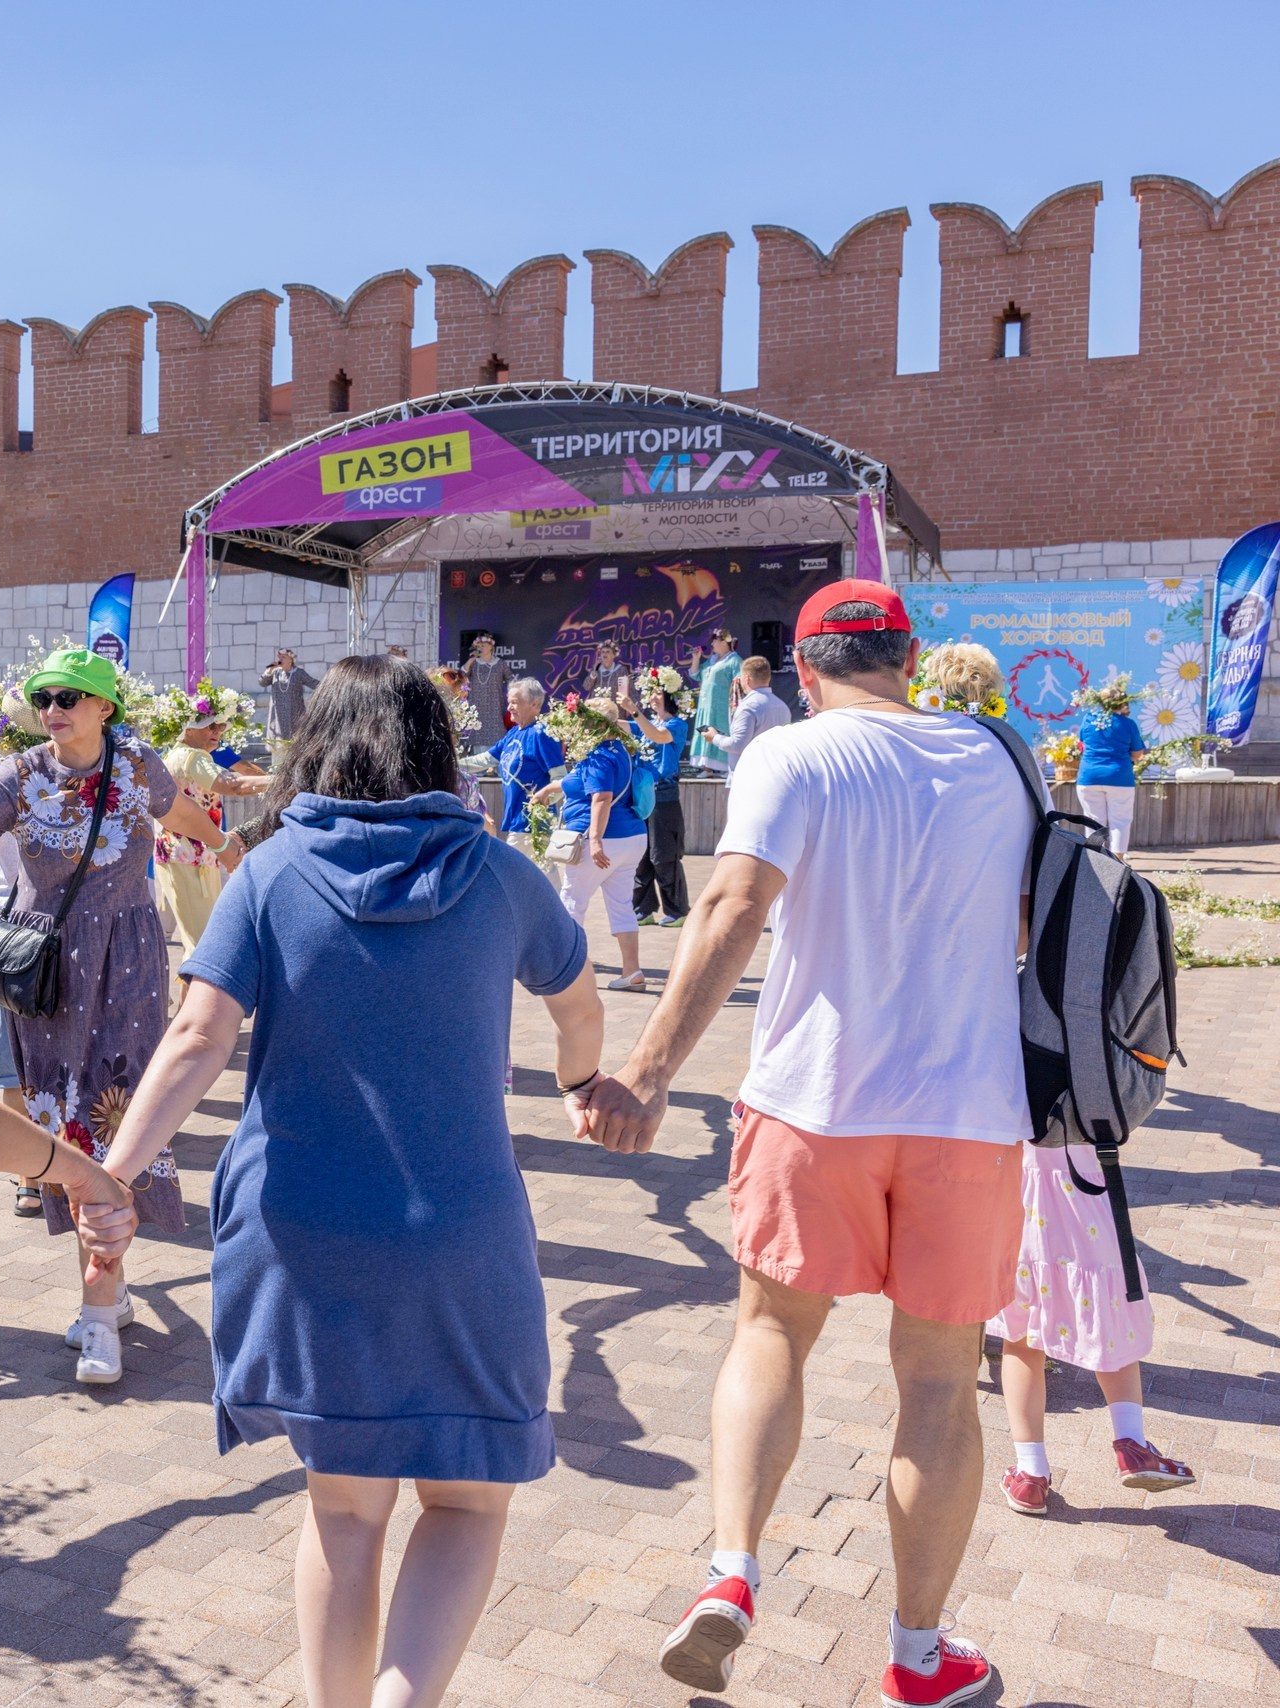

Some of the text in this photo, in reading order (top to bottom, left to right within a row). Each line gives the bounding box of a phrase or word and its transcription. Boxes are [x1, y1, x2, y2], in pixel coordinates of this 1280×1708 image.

[531, 424, 722, 460] ТЕРРИТОРИЯ
[337, 441, 453, 485] ГАЗОН
[787, 471, 828, 487] TELE2
[359, 486, 427, 510] фест
[641, 500, 714, 513] ТЕРРИТОРИЯ
[658, 512, 738, 526] МОЛОДОСТИ
[535, 524, 580, 539] фест
[970, 608, 1131, 629] РОМАШКОВЫЙ
[999, 629, 1105, 647] ХОРОВОД
